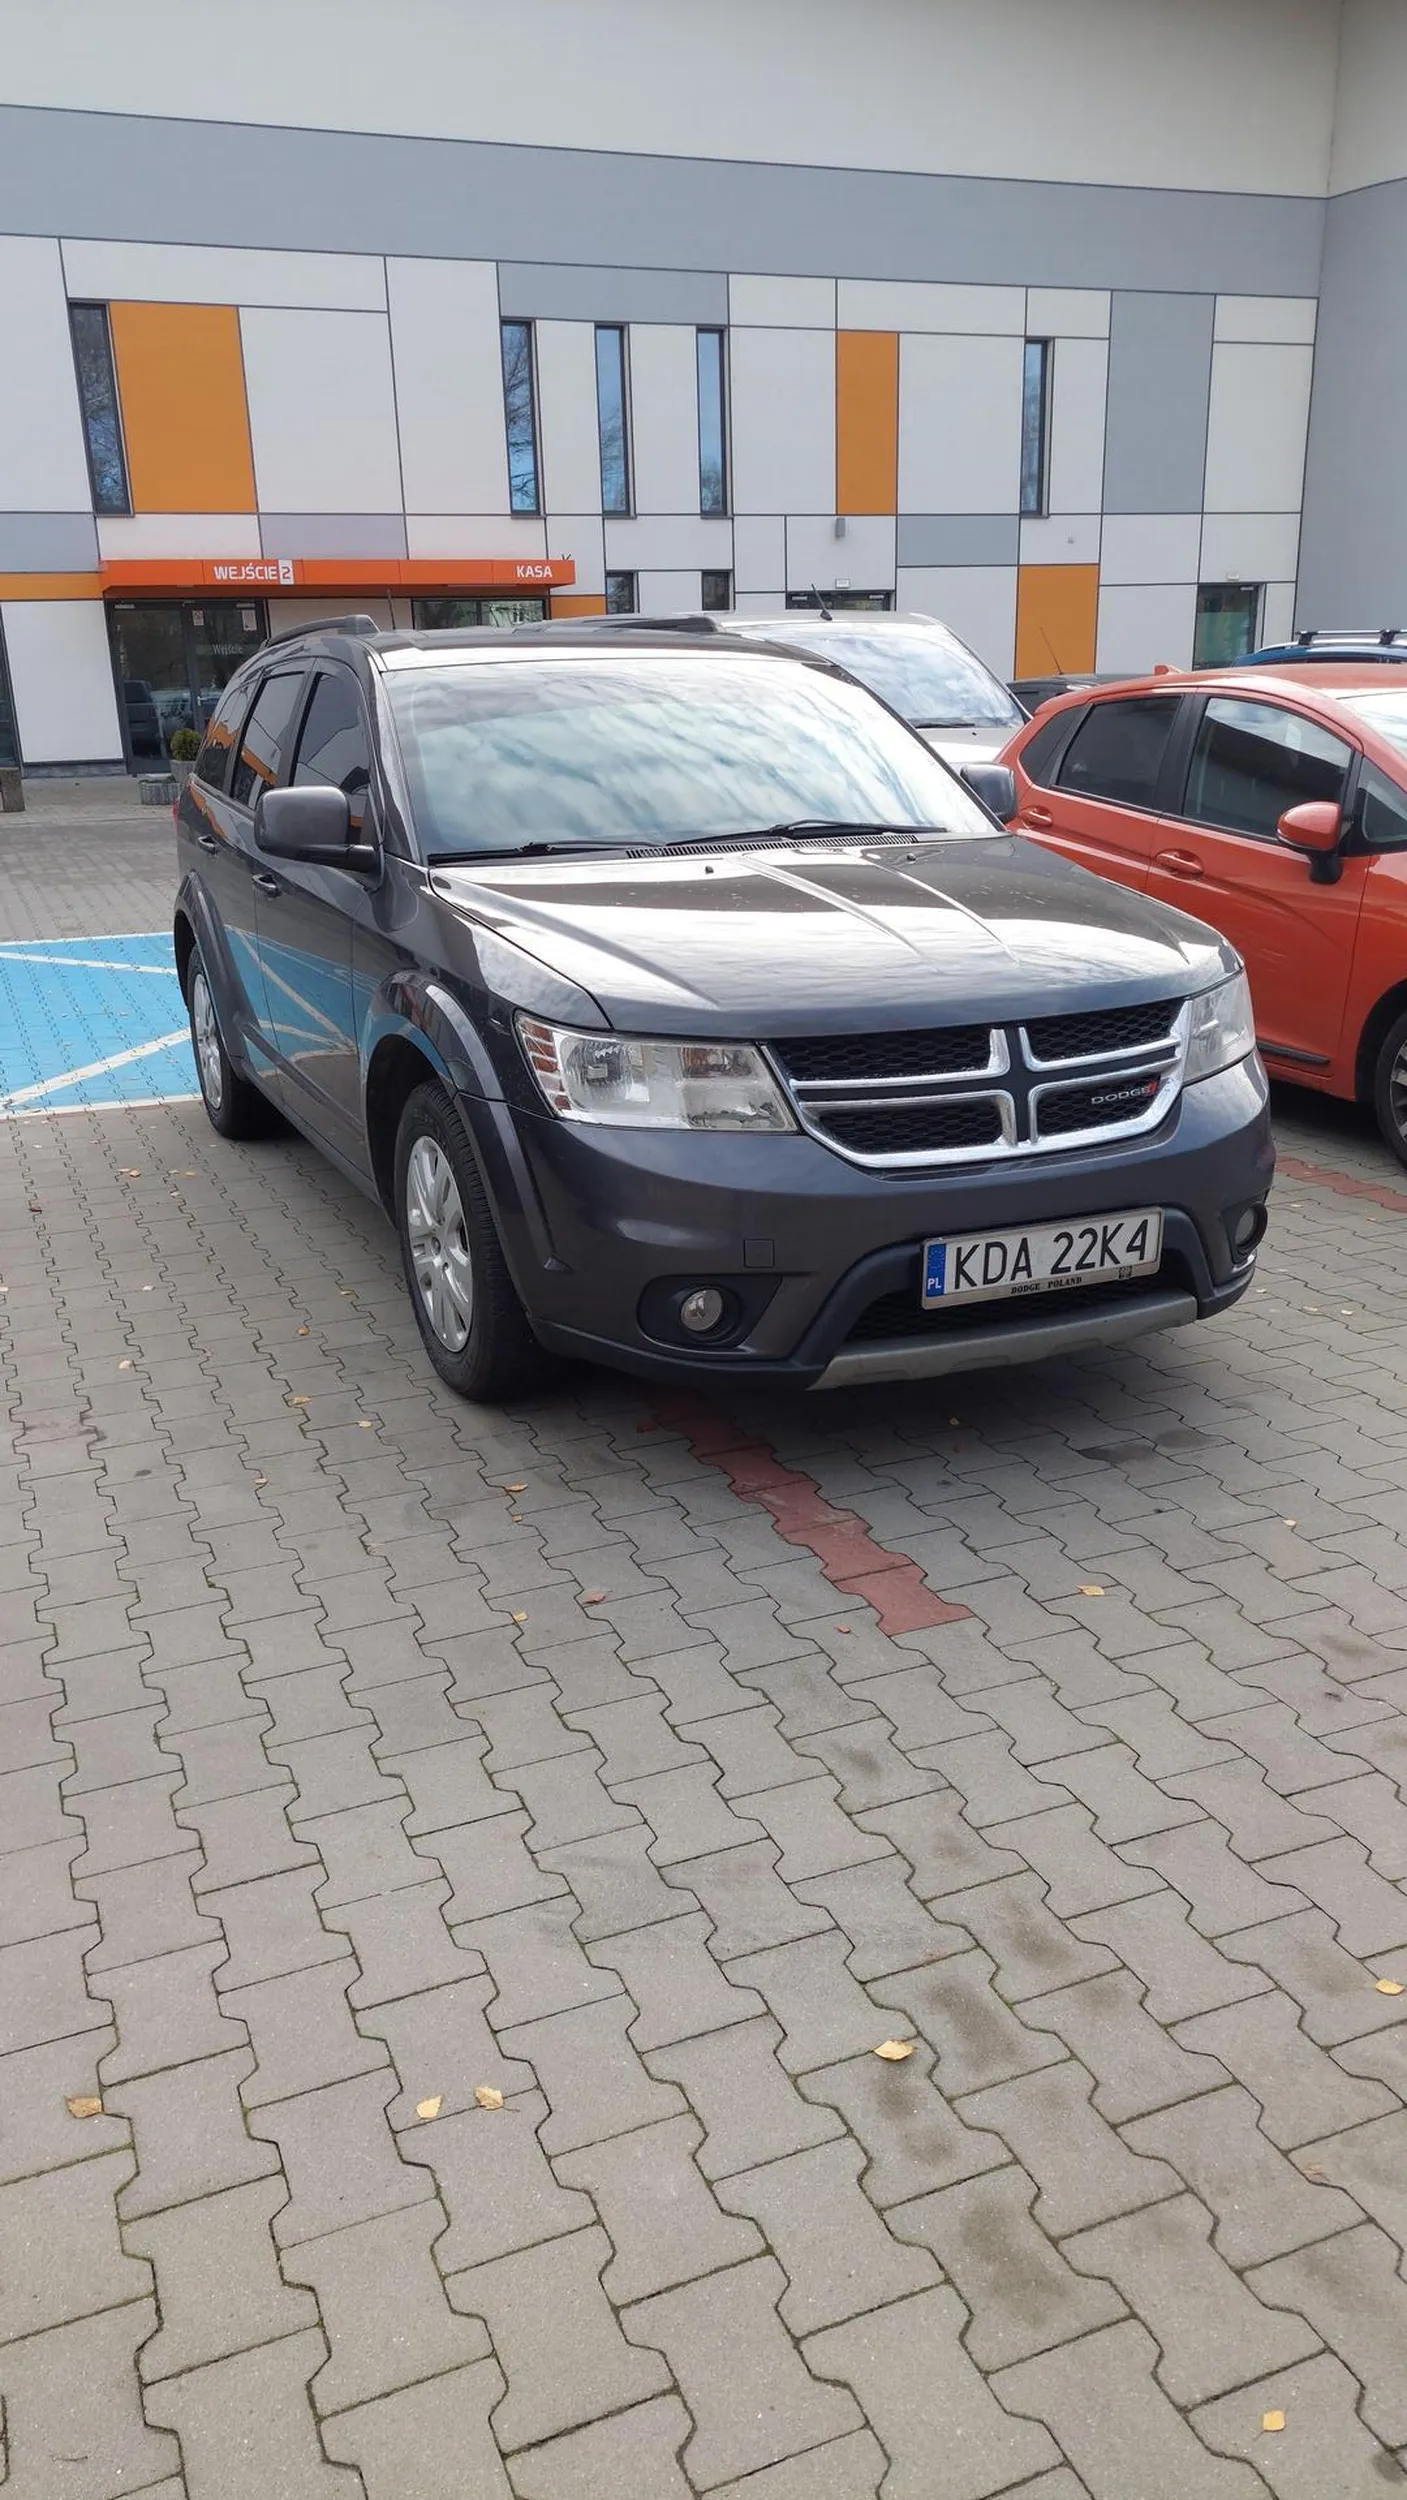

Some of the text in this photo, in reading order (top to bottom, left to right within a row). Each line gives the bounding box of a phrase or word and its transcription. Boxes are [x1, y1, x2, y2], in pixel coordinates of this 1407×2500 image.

[214, 562, 292, 580] WEJŚCIE 2
[516, 565, 553, 578] KASA
[1091, 1085, 1150, 1105] DODGE
[954, 1219, 1149, 1290] KDA 22K4
[927, 1277, 942, 1290] PL
[1011, 1276, 1082, 1295] DODGE POLAND
